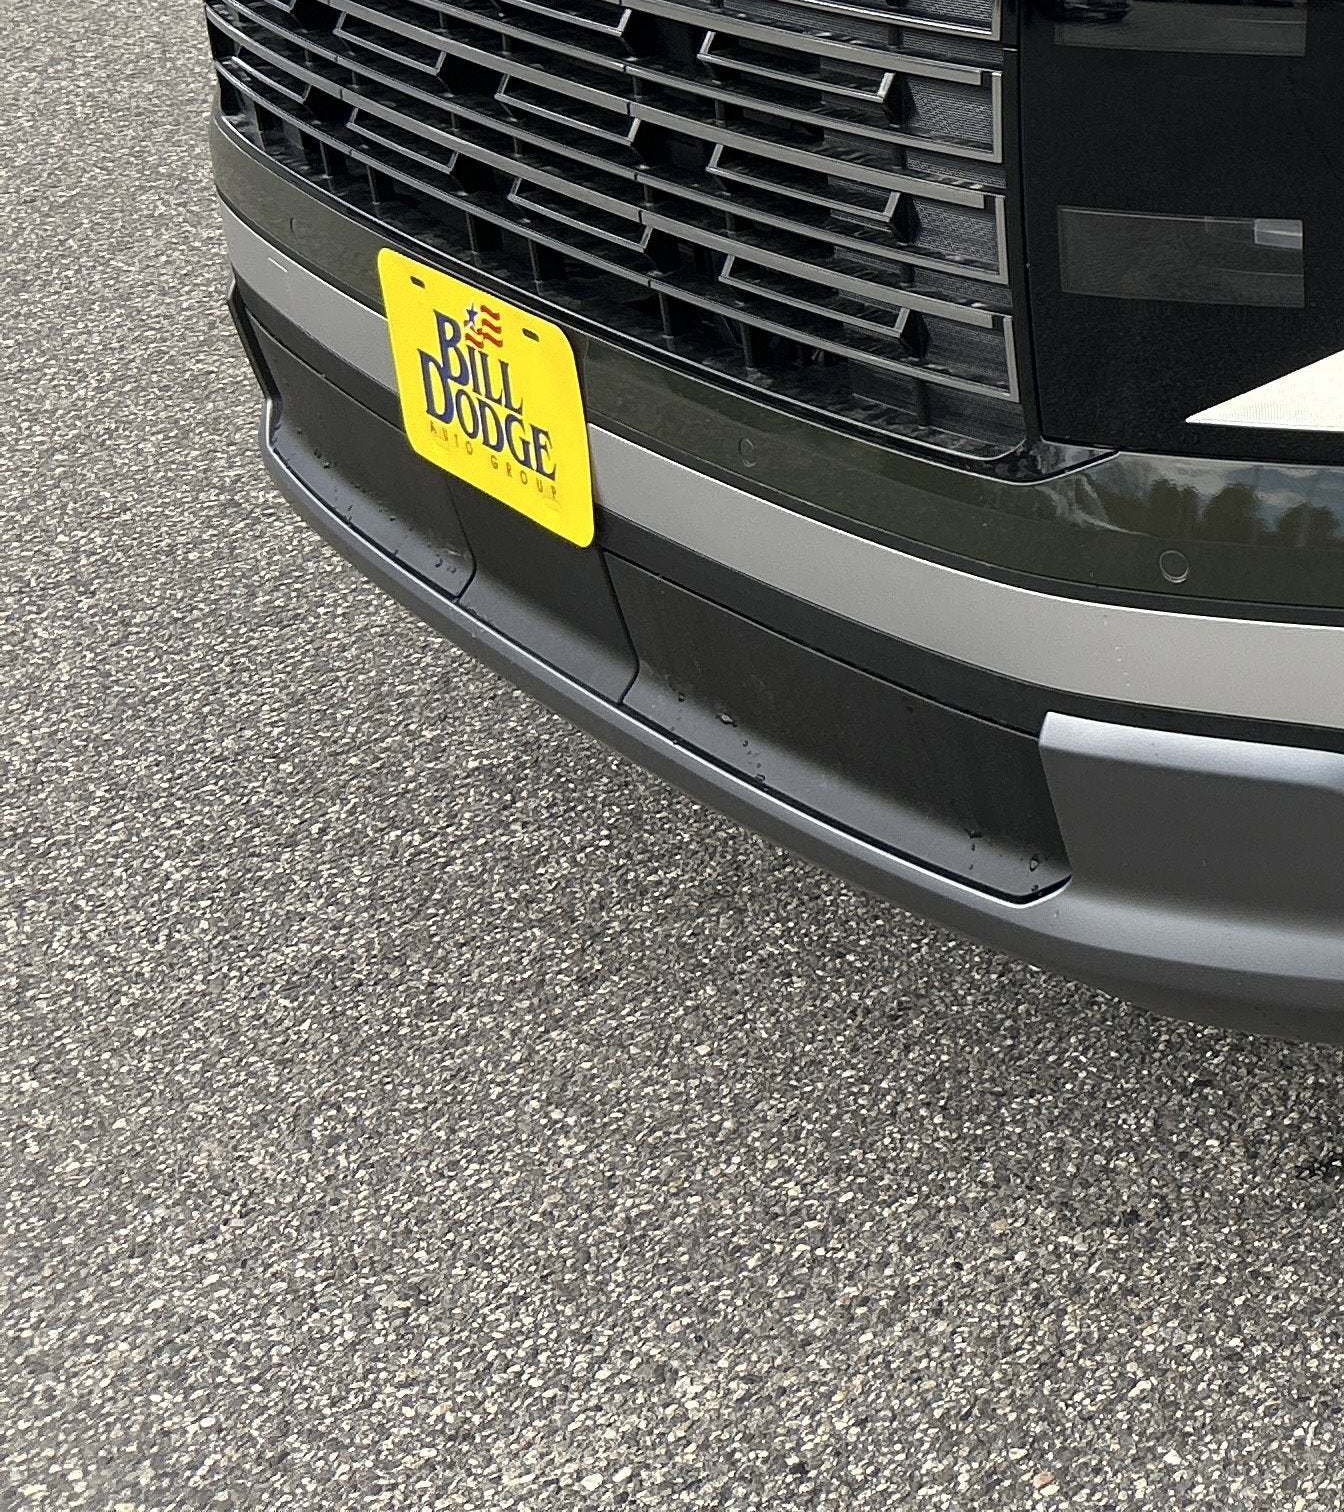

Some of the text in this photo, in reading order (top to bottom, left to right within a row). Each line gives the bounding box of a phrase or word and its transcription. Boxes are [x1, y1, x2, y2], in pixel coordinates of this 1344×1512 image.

[417, 348, 557, 480] DODGE
[433, 309, 523, 415] BILL
[429, 420, 559, 502] AUTO GROUP
